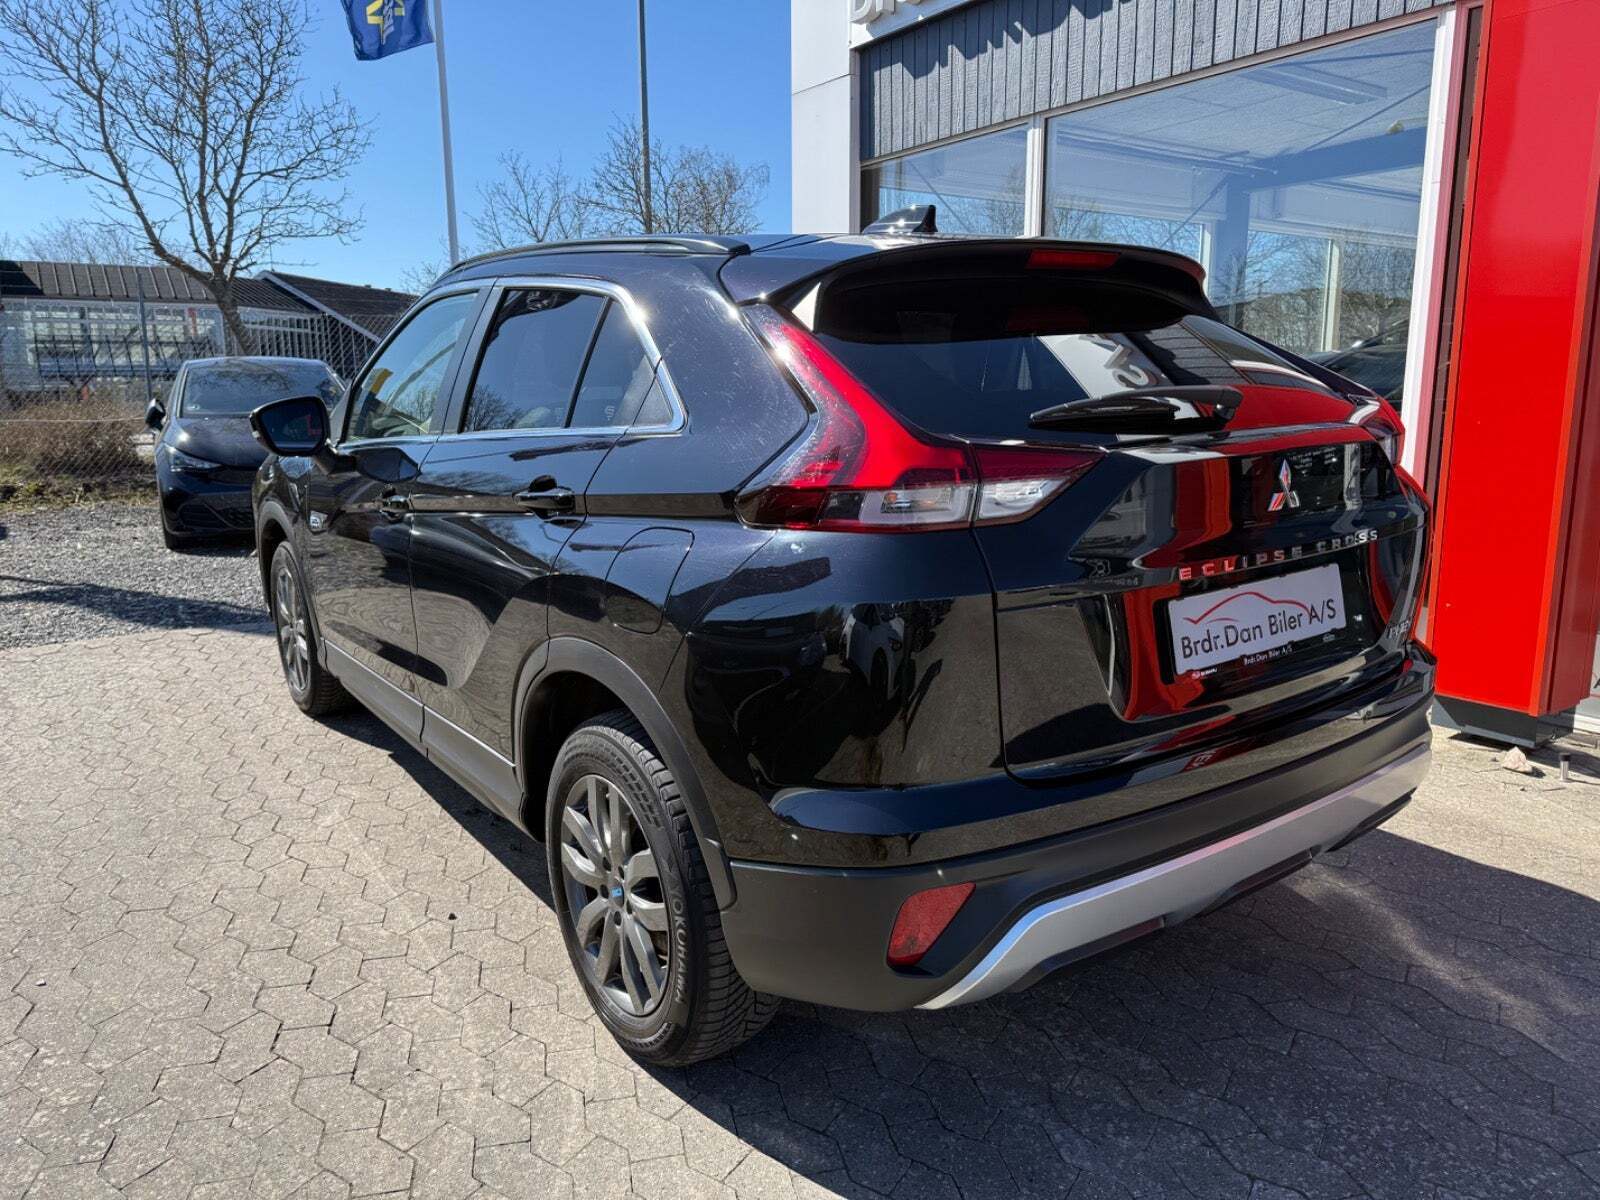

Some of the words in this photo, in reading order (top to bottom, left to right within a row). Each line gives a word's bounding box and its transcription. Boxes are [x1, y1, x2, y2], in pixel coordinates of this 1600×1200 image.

[1179, 546, 1303, 580] ECLIPSE
[1317, 529, 1378, 552] CROSS
[1181, 625, 1263, 659] Brdr.Dan
[1268, 611, 1303, 636] Biler
[1308, 598, 1336, 625] A/S
[670, 884, 688, 1003] YOKOHAMA
